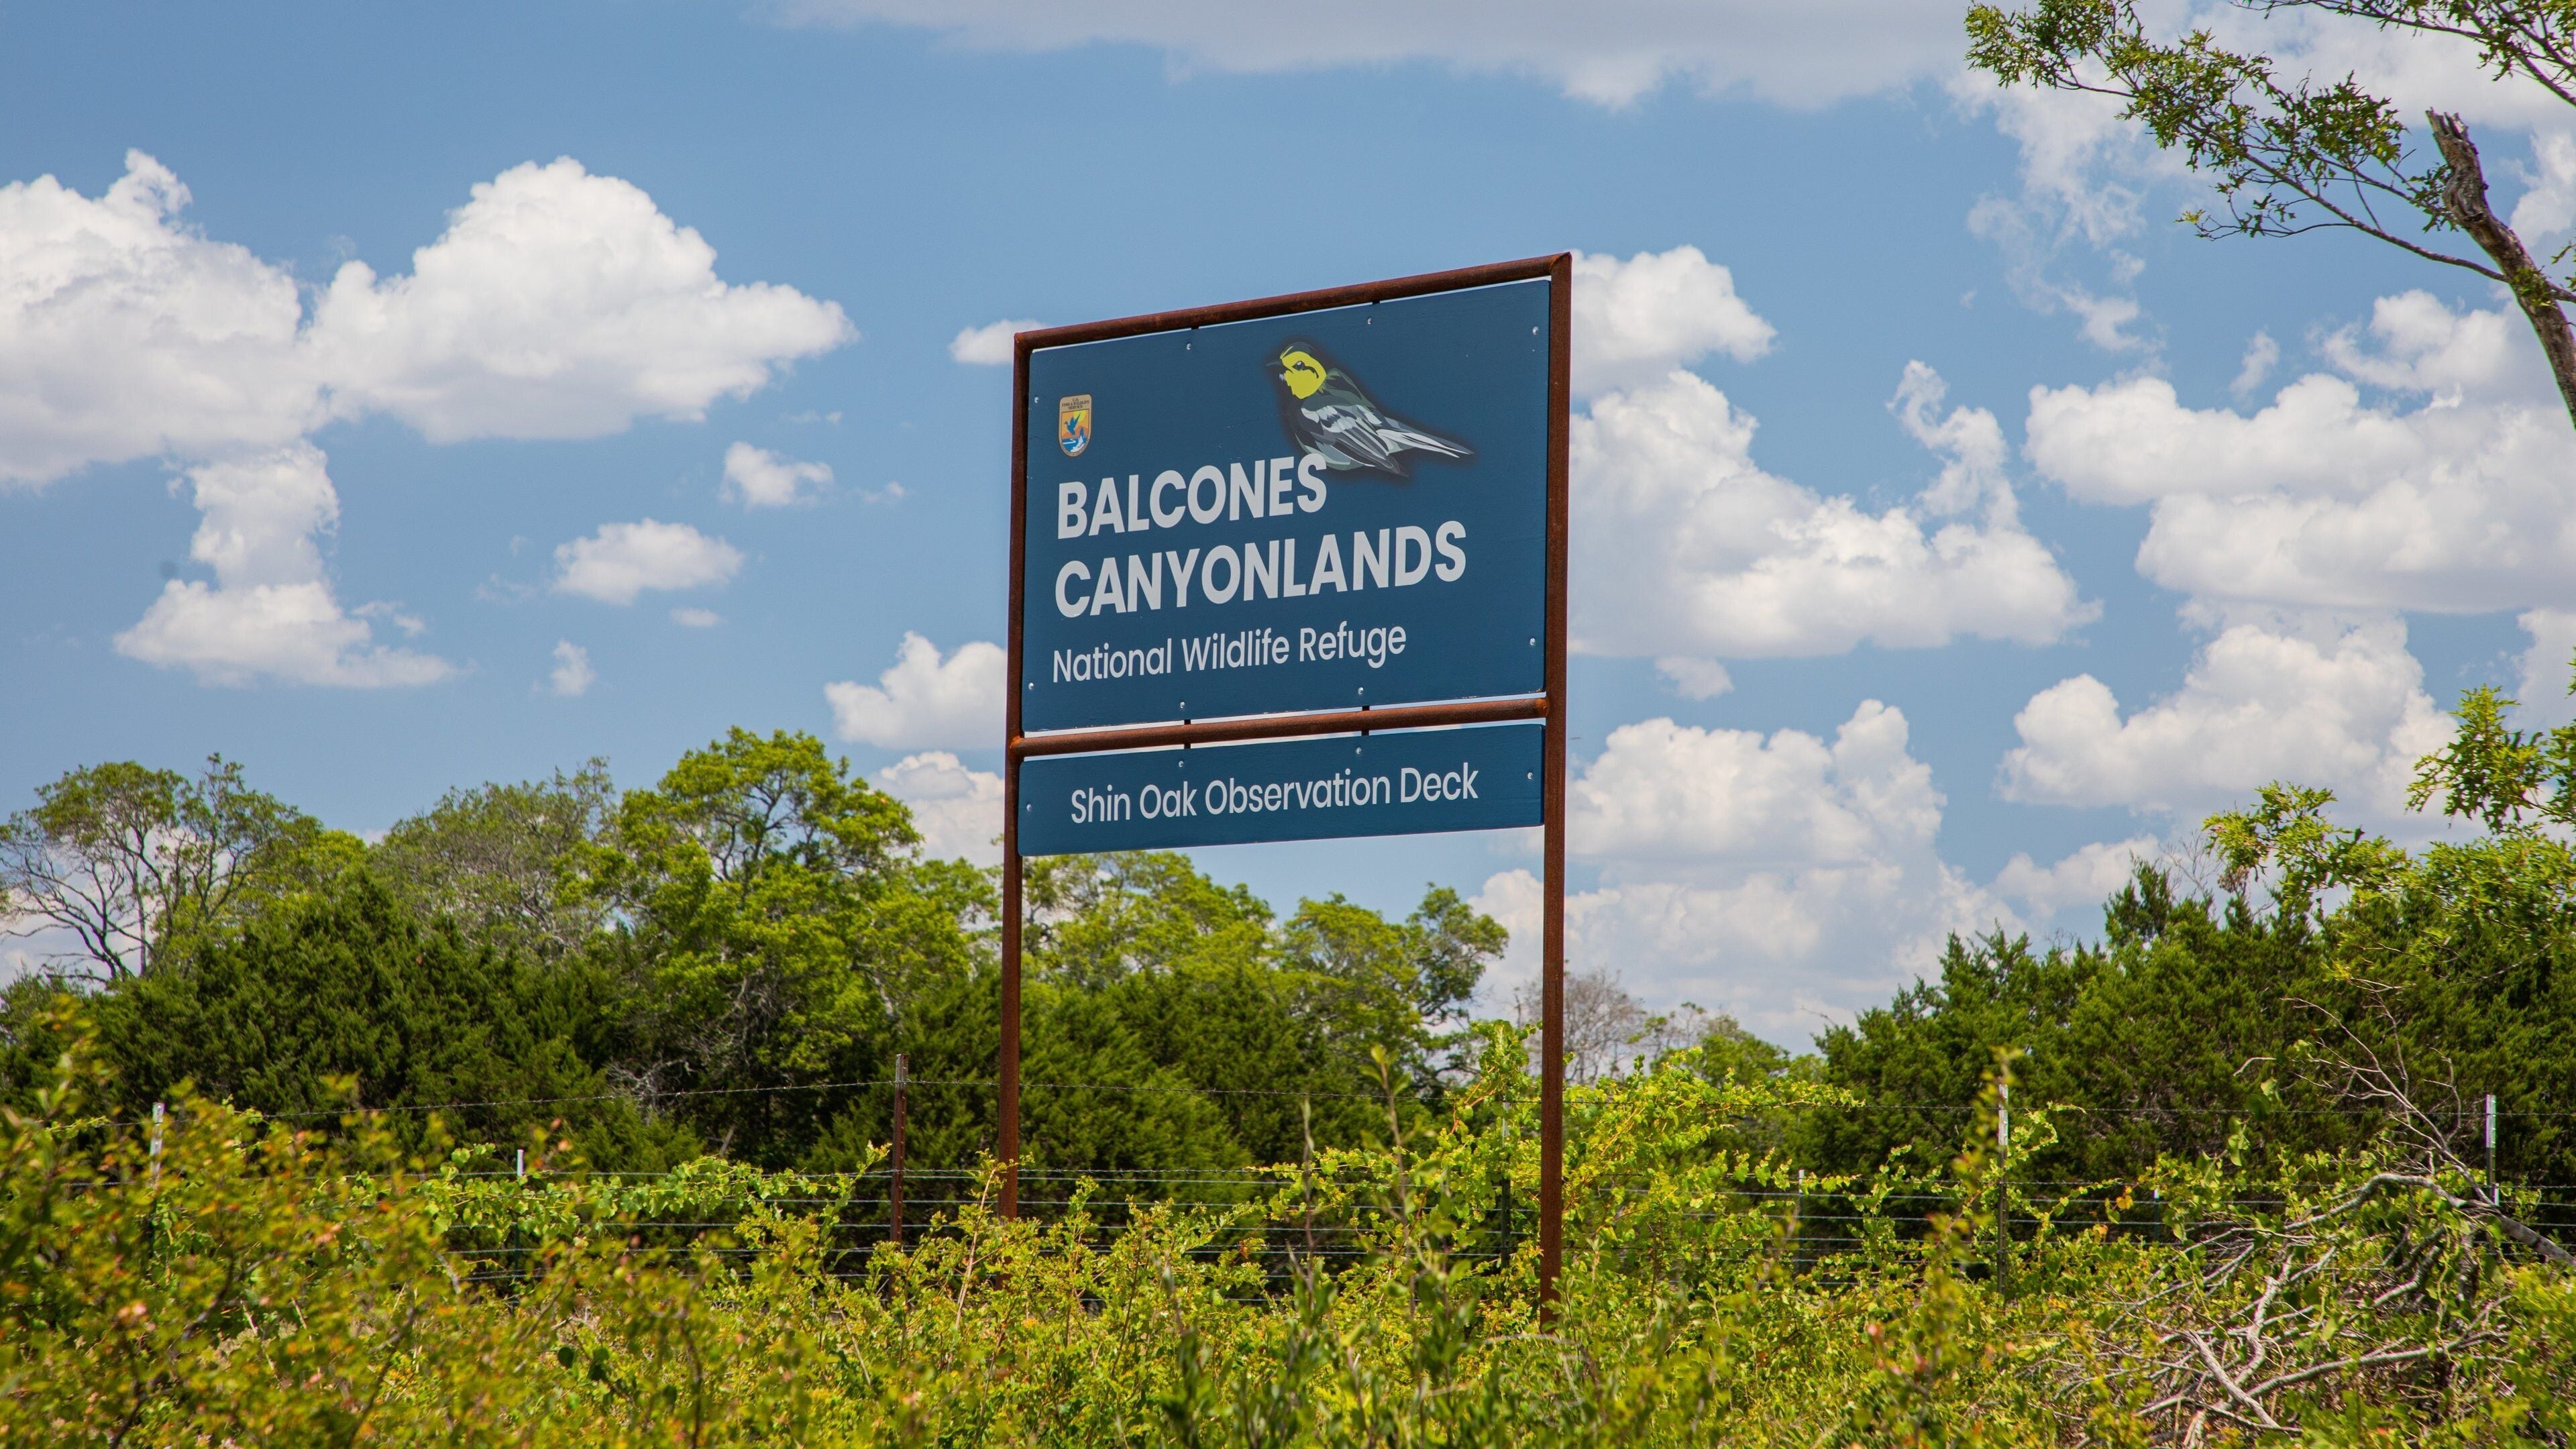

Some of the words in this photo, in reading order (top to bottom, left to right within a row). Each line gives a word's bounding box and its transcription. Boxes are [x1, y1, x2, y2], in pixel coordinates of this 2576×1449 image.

[1058, 453, 1328, 539] BALCONES
[1055, 521, 1466, 619] CANYONLANDS
[1053, 638, 1172, 684] National
[1181, 627, 1289, 672] Wildlife
[1299, 621, 1407, 669] Refuge
[1071, 784, 1131, 824] Shin
[1140, 781, 1198, 819] Oak
[1205, 768, 1391, 814] Observation
[1401, 762, 1479, 804] Deck
